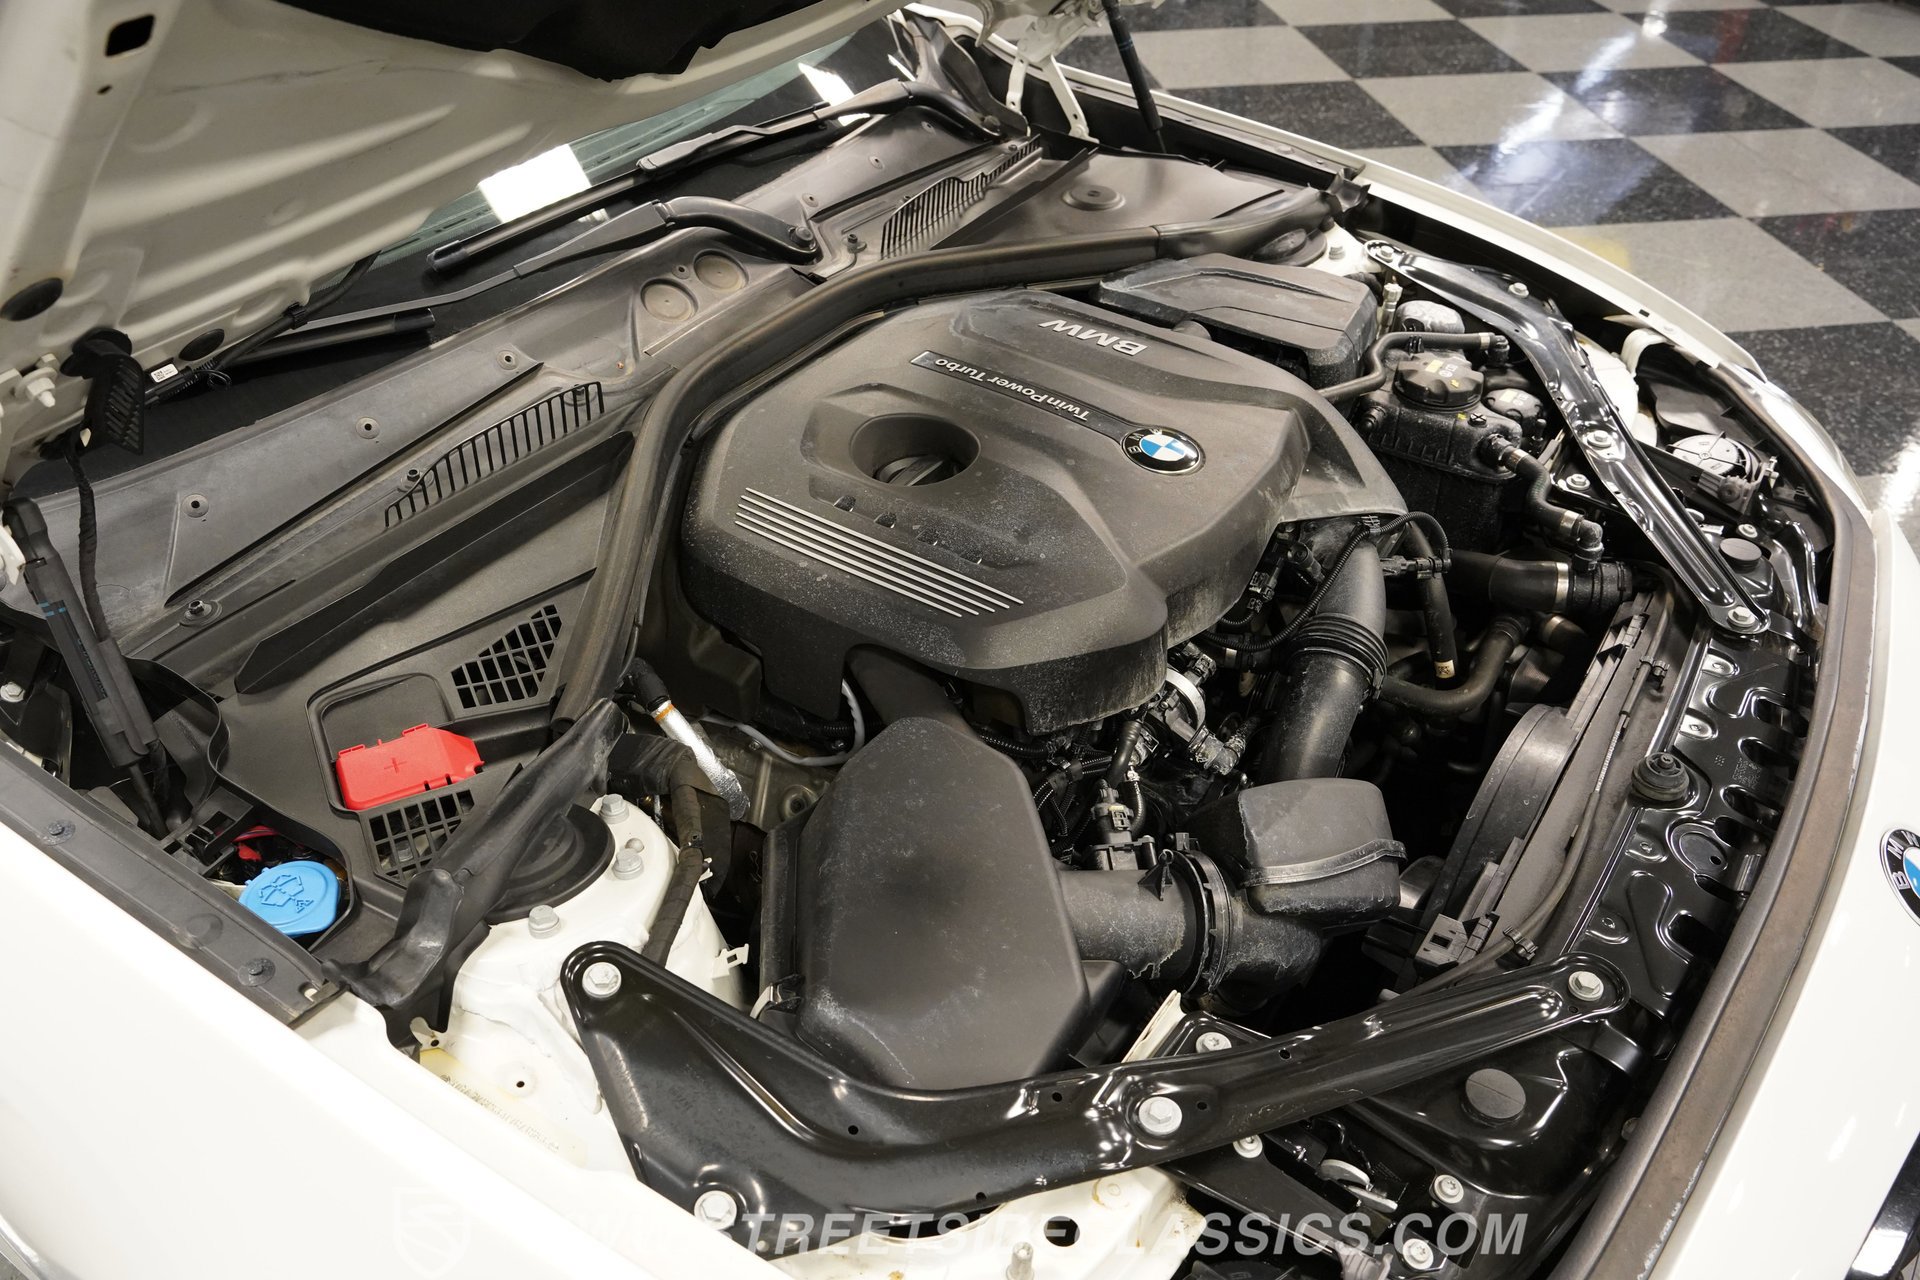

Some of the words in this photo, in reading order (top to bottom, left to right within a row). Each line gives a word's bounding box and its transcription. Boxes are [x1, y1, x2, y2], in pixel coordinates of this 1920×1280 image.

[1038, 319, 1148, 356] BMW
[935, 358, 983, 382] Turbo
[987, 376, 1088, 421] TwinPower
[1887, 830, 1920, 889] BMW
